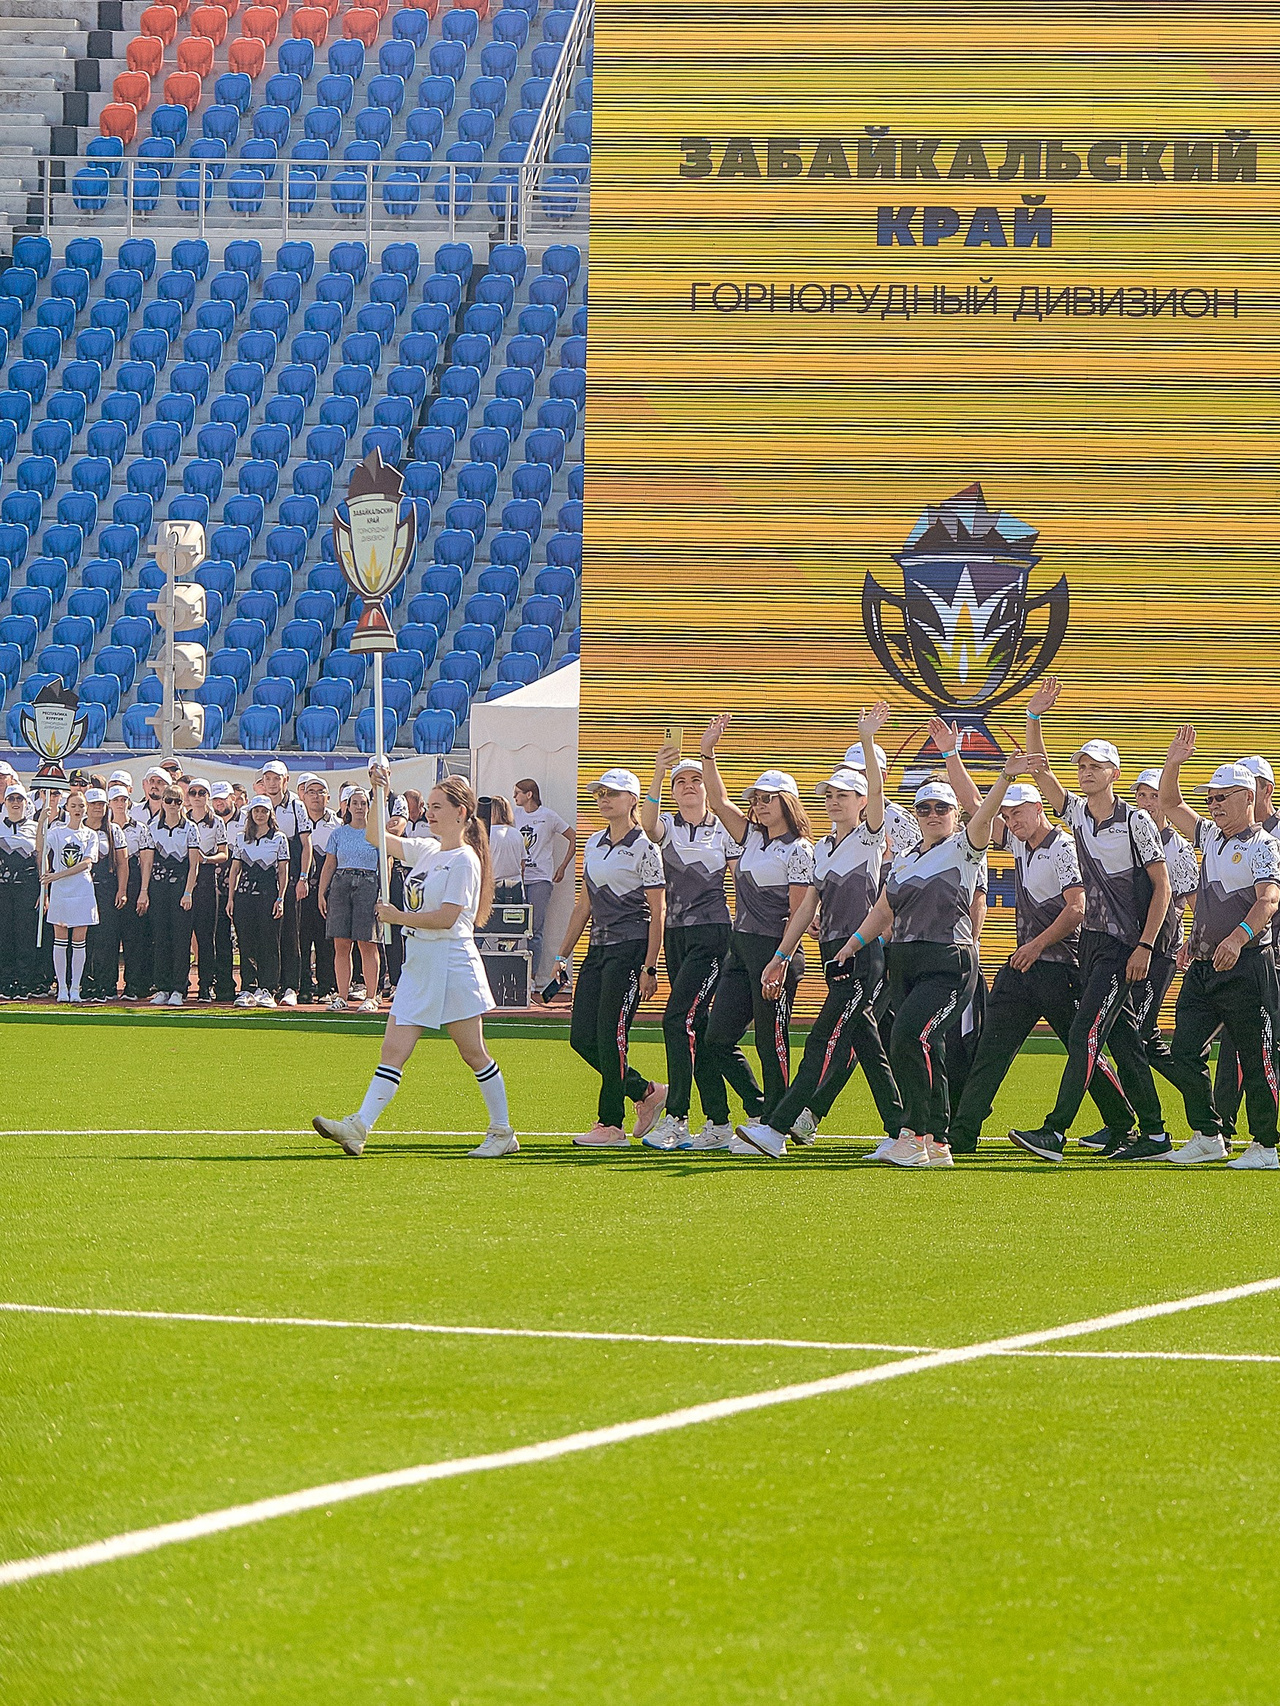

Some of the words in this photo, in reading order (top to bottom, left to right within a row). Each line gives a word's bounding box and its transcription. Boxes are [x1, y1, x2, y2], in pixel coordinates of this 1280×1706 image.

[679, 126, 1258, 183] ЗАБАЙКАЛЬСКИЙ
[876, 194, 1053, 248] КРАЙ
[690, 276, 998, 322] ГОРНОРУДНЫЙ
[1013, 286, 1239, 323] ДИВИЗИОН
